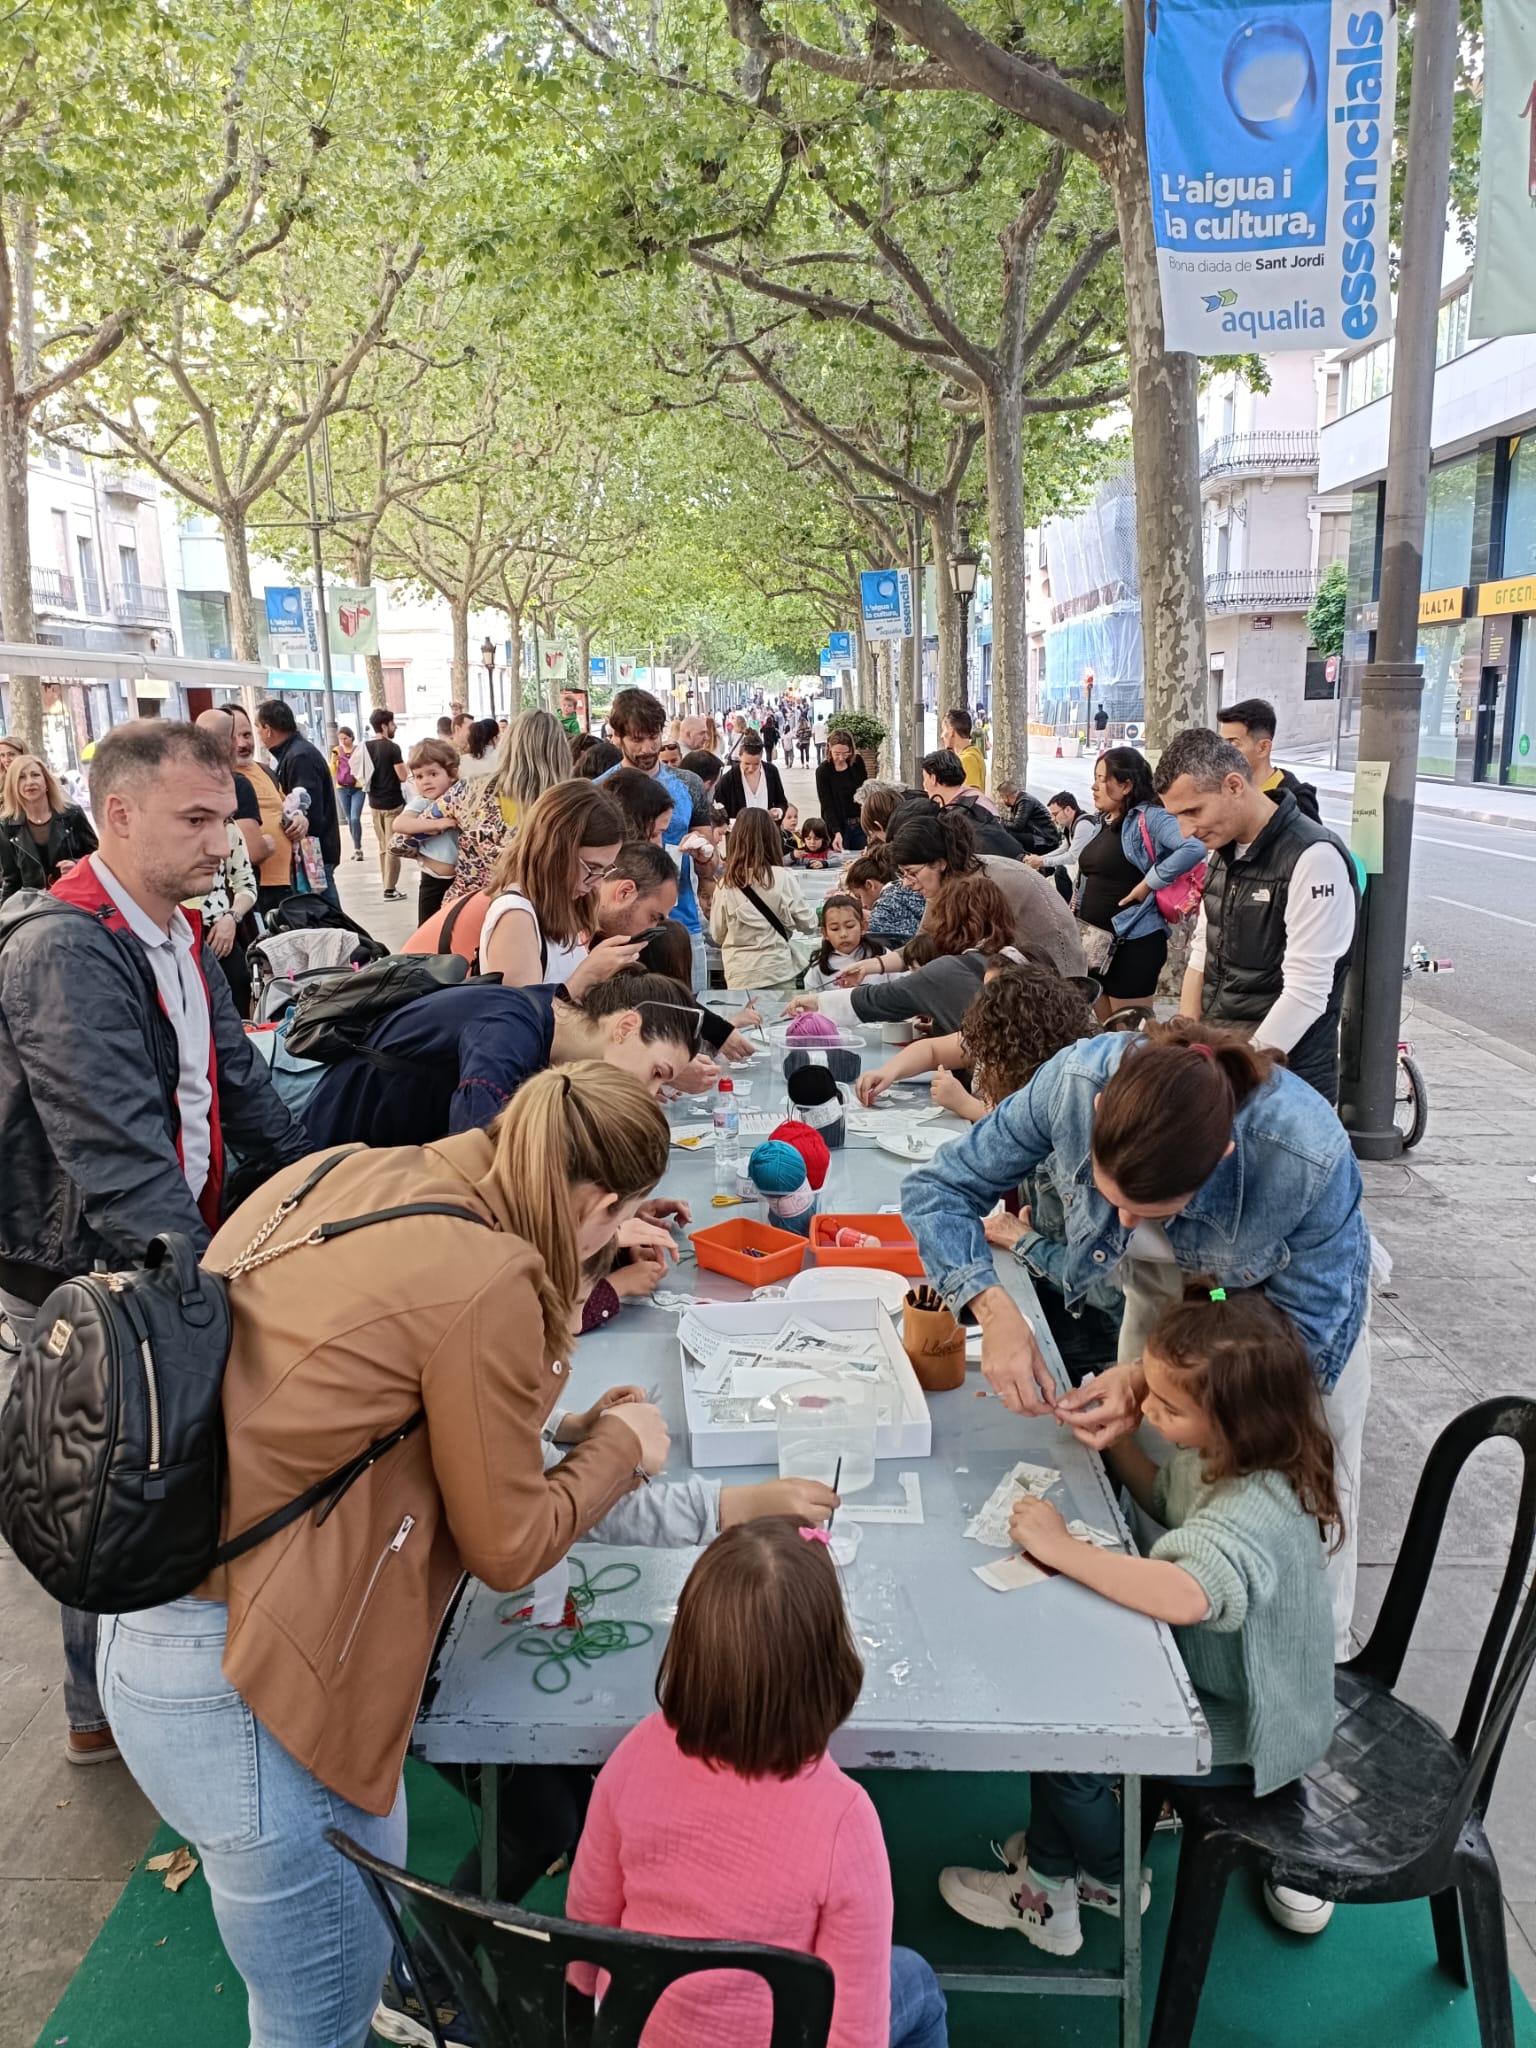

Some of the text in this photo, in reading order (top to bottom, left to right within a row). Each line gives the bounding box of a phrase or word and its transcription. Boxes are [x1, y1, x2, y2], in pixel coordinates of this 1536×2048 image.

[1281, 168, 1293, 198] i
[1334, 10, 1384, 340] essencials
[1165, 210, 1316, 241] la cultura,
[1169, 253, 1325, 274] Bona diada de Sant Jordi
[1221, 299, 1326, 340] aqualia
[900, 573, 912, 636] essencials
[1421, 598, 1455, 616] ILALTA
[304, 591, 318, 653] essencials
[1311, 883, 1335, 899] HH
